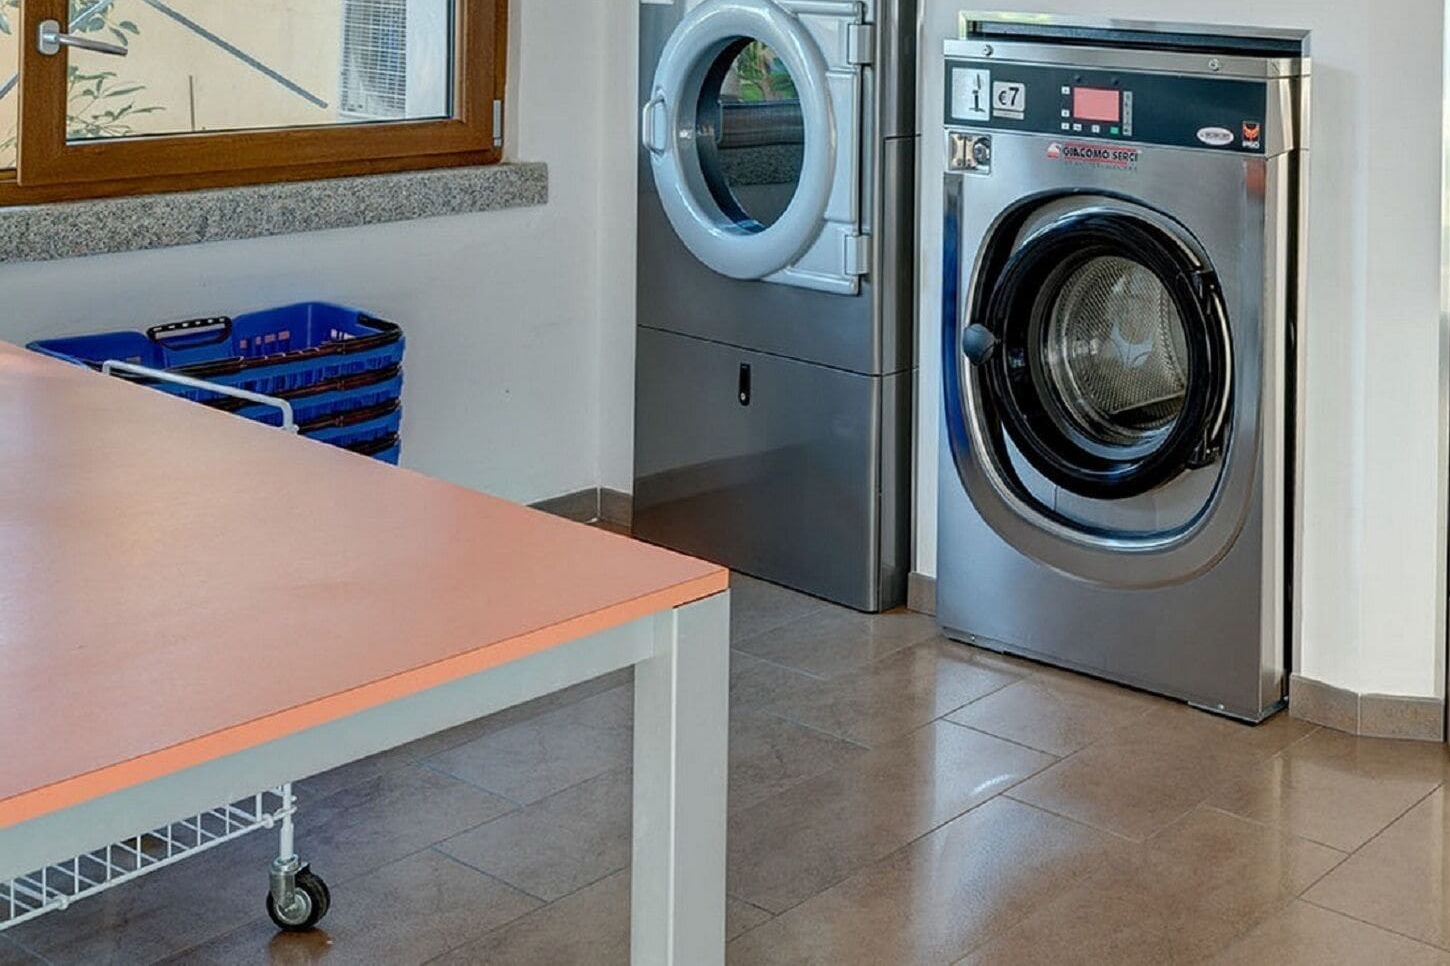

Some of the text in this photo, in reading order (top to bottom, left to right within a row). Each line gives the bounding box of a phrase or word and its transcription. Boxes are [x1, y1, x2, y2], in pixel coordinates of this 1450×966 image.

[998, 86, 1020, 106] €7
[1062, 146, 1139, 163] GIACOMO SERCI
